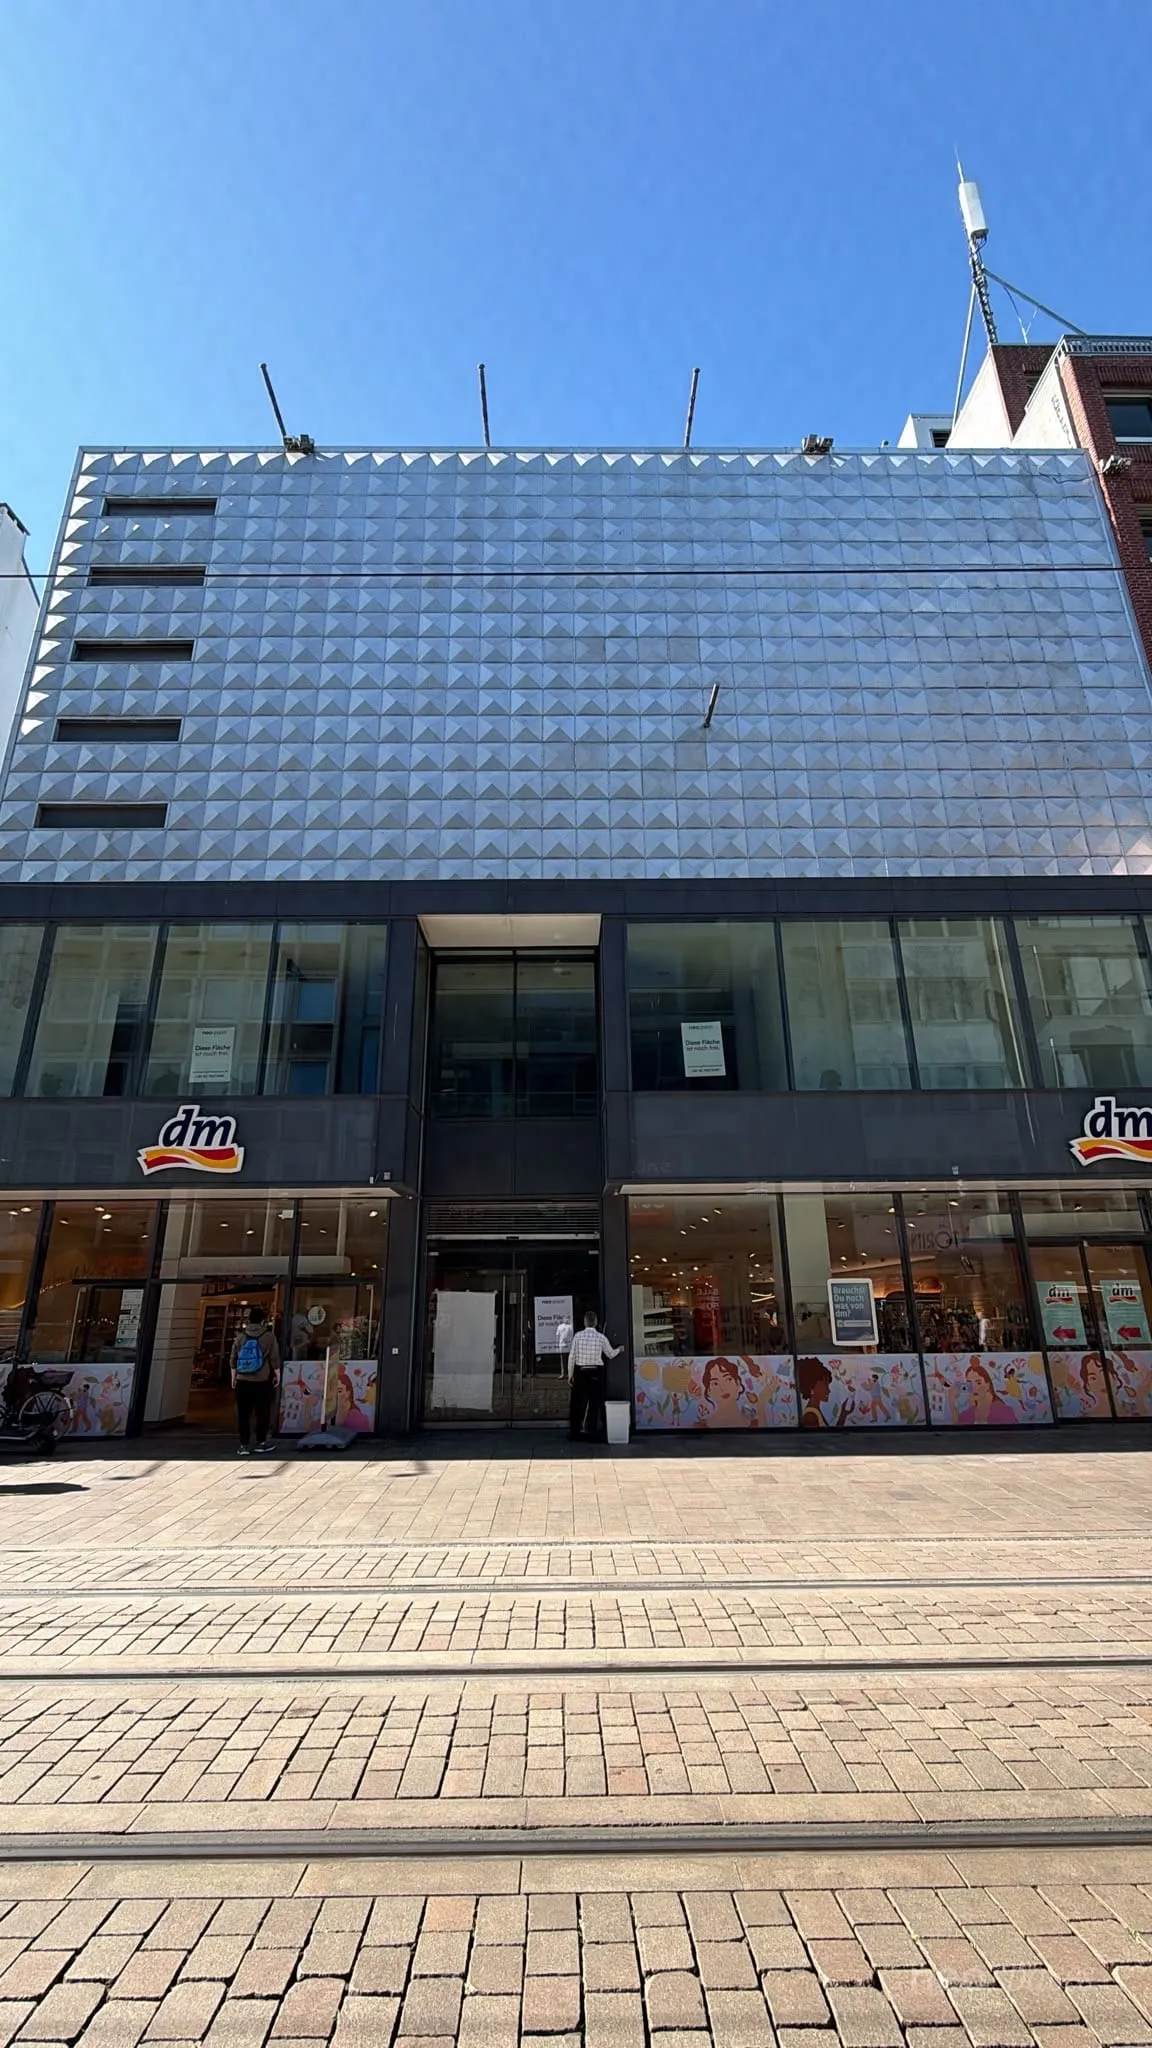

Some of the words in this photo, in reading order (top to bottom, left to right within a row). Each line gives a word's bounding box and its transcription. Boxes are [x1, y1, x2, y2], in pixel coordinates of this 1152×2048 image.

[162, 1109, 231, 1147] dm
[1049, 1284, 1070, 1297] dm
[1112, 1283, 1133, 1296] dm
